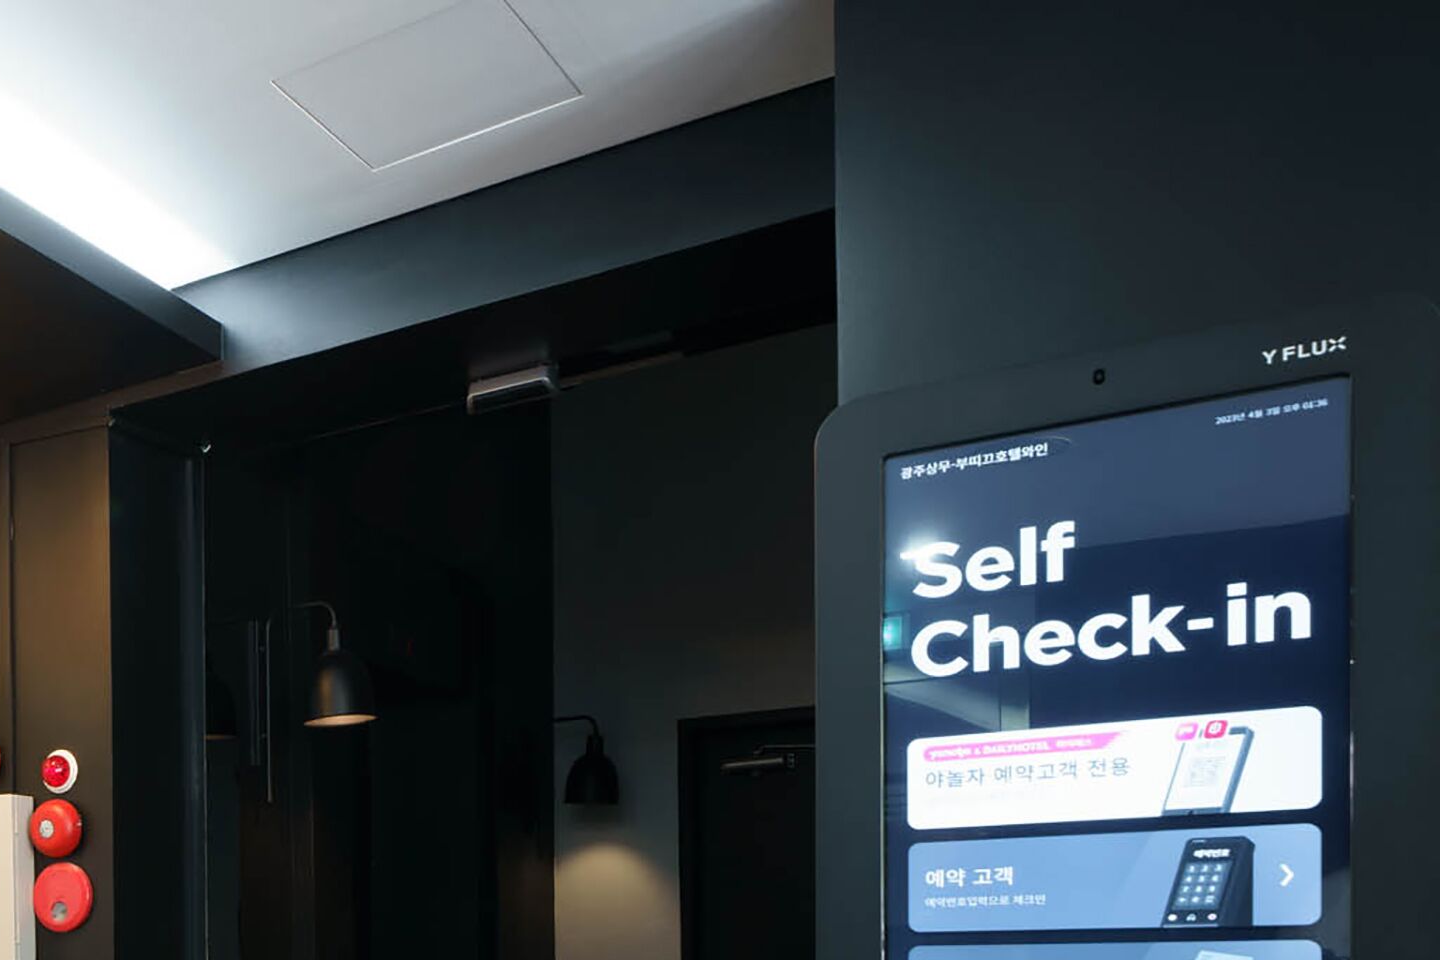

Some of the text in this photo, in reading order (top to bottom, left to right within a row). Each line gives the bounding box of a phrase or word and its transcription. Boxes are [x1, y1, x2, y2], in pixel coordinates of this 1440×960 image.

[1282, 336, 1347, 362] FLUX
[911, 520, 1076, 599] Self
[911, 581, 1313, 678] Check-in
[925, 756, 1130, 788] 야놀자 예약고객 전용
[925, 866, 1014, 888] 예약 고객
